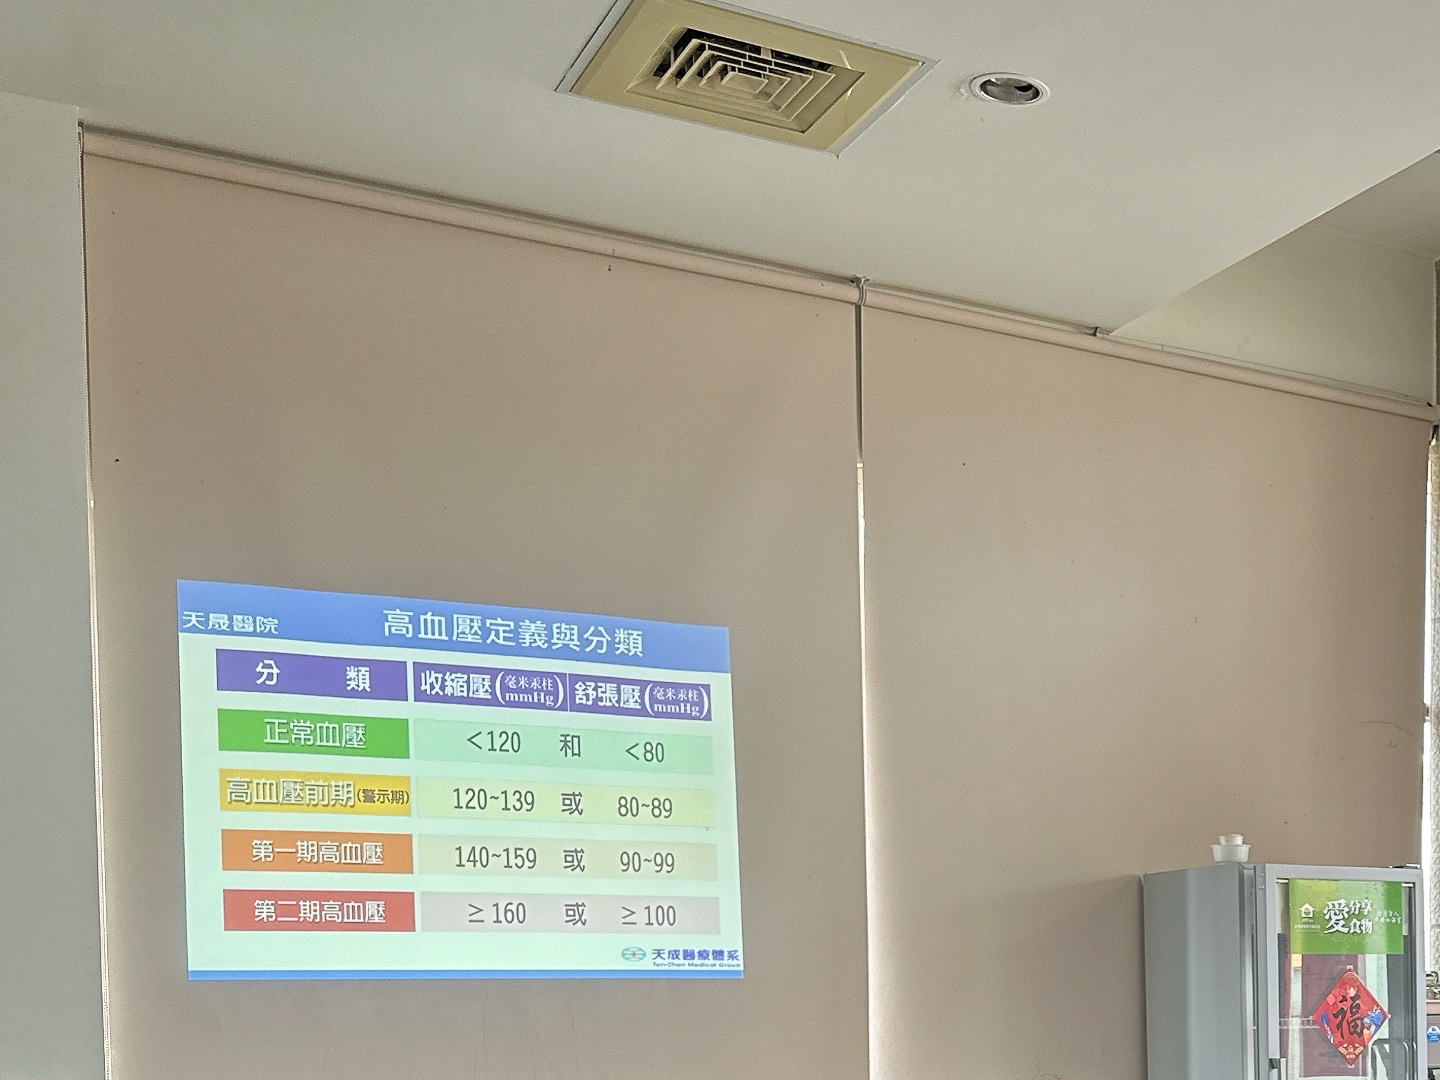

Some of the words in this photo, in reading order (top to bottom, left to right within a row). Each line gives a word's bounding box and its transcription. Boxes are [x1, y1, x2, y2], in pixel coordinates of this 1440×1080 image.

[182, 611, 279, 634] 天晟醫院
[383, 608, 644, 657] 高血壓定義與分類
[255, 659, 280, 685] 分
[345, 666, 371, 692] 類
[420, 670, 492, 699] 收縮壓
[574, 681, 642, 710] 舒張壓
[264, 718, 366, 748] 正常血壓
[559, 733, 581, 758] 和
[561, 791, 584, 816] 或
[251, 839, 385, 865] 第一期高血壓
[563, 848, 586, 872] 或
[254, 900, 387, 924] 第二期高血壓
[564, 902, 587, 926] 或
[1323, 899, 1350, 934] 愛
[1350, 899, 1373, 915] 分享
[1350, 918, 1373, 934] 食物
[652, 949, 740, 961] 天成醫療體系
[1333, 994, 1364, 1039] 福
